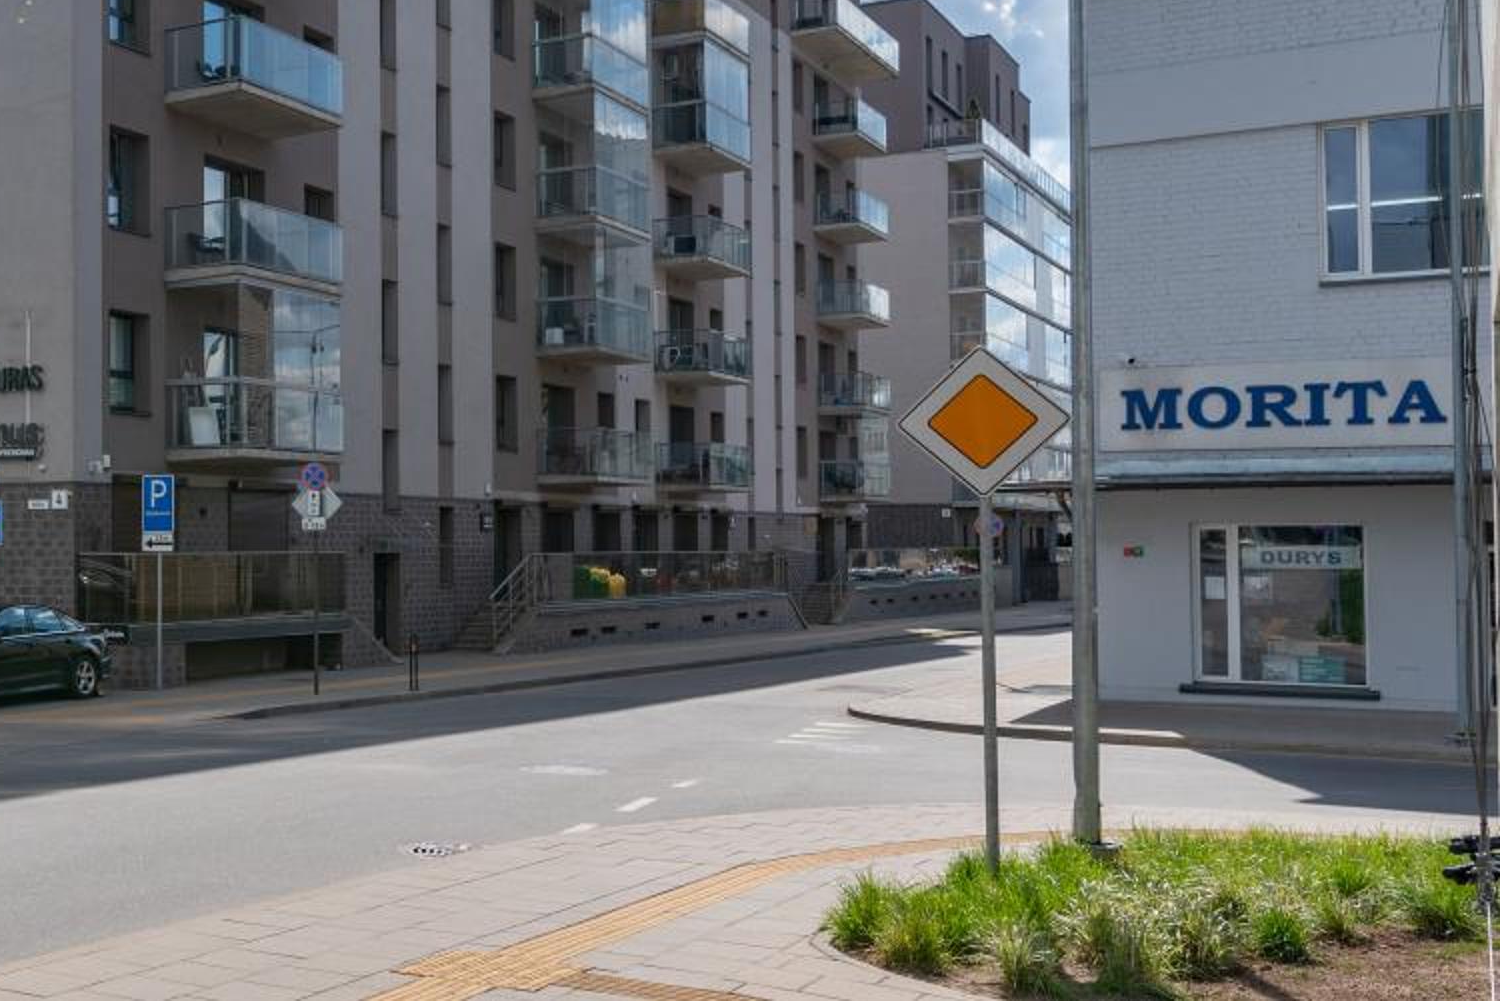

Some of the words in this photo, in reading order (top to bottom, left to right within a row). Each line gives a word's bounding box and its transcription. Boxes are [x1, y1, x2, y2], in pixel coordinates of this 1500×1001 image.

[1120, 380, 1448, 431] MORITA
[151, 480, 167, 508] P
[1261, 550, 1342, 565] DURYS
